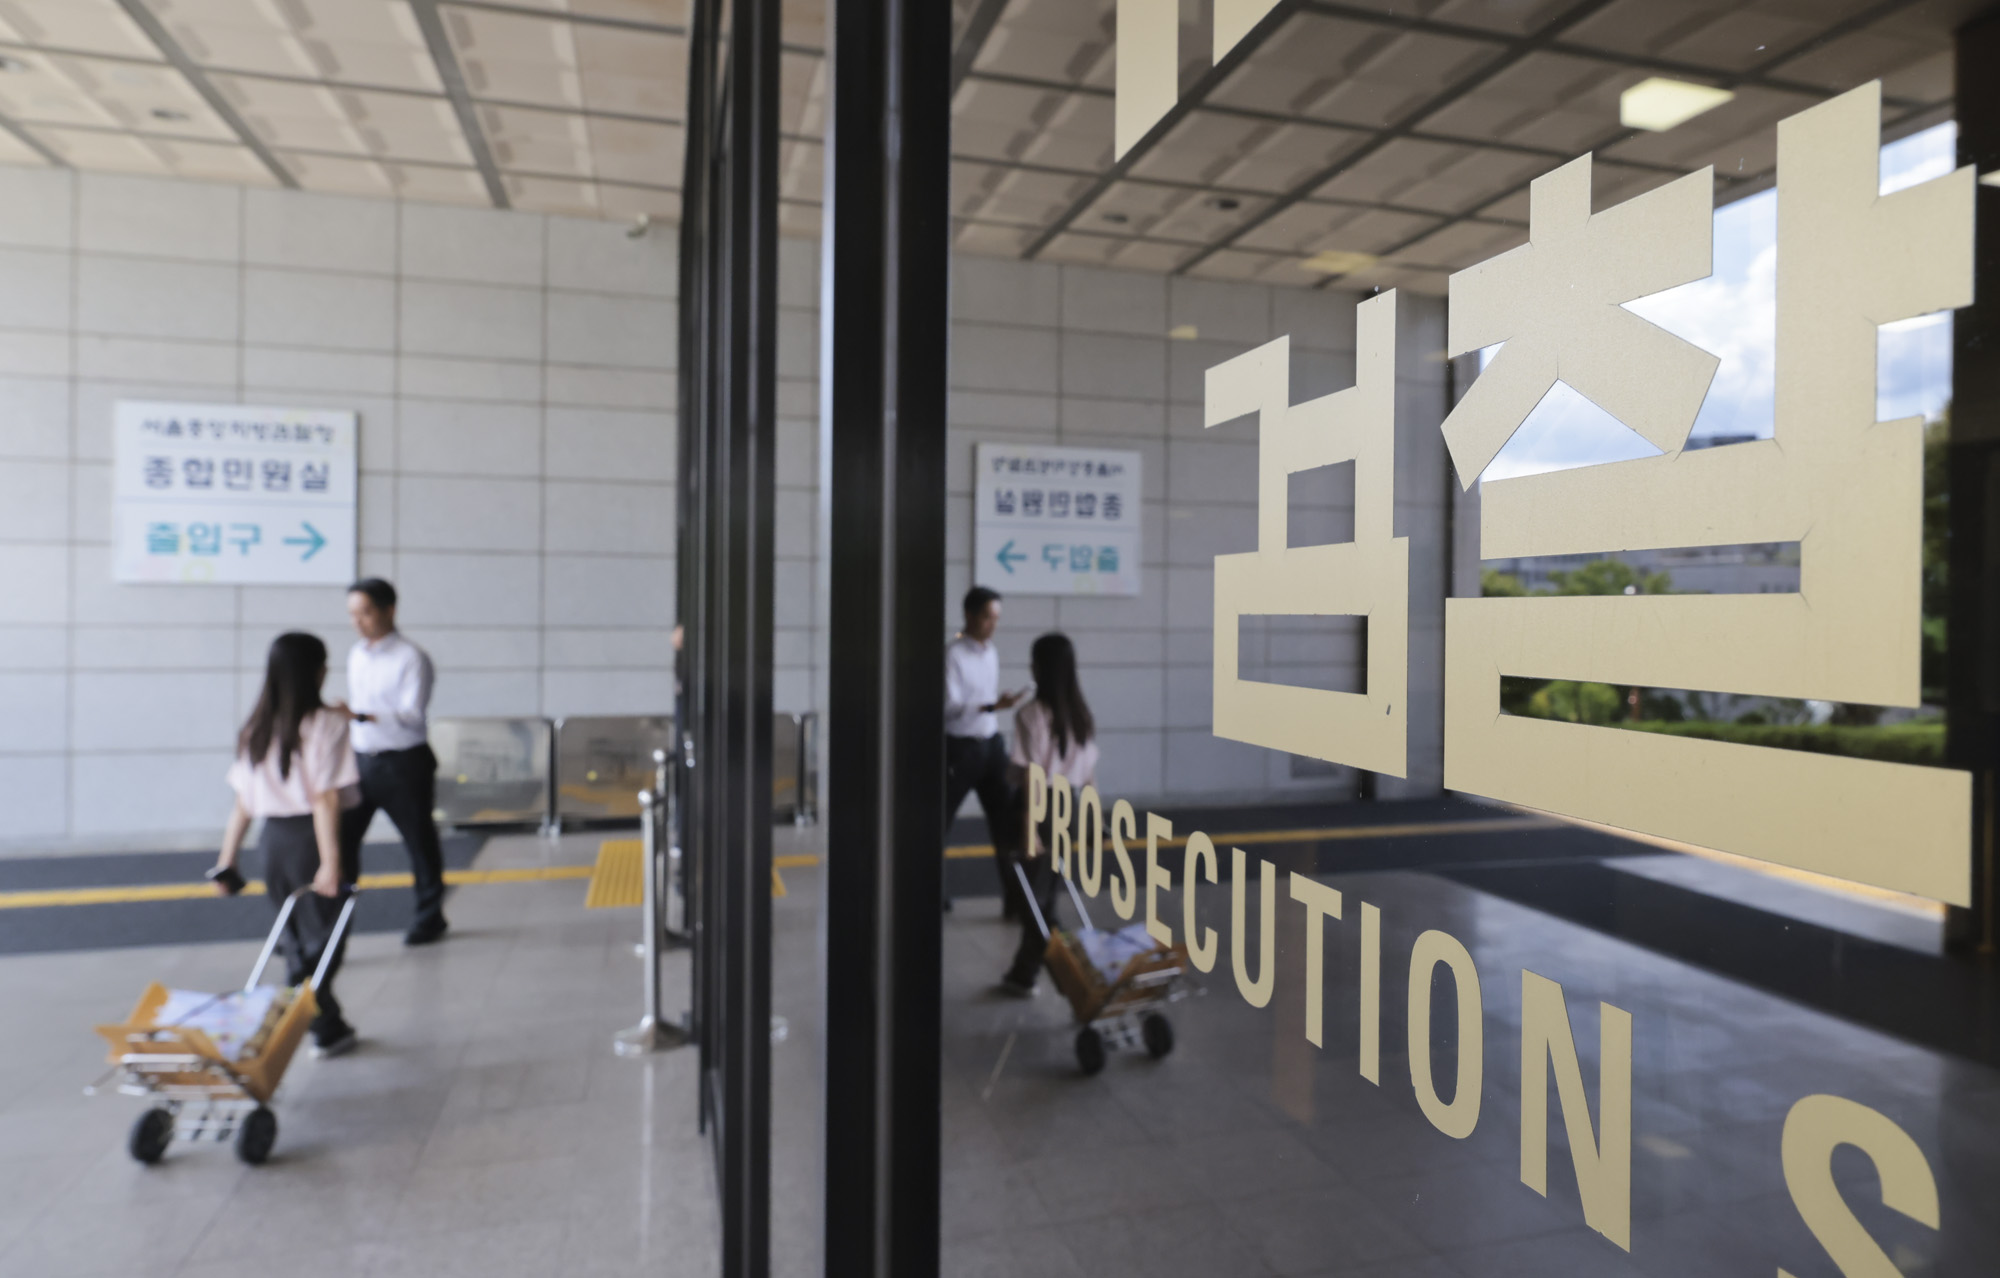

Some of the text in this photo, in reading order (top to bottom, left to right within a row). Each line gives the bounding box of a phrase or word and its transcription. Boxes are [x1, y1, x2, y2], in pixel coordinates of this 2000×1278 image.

[144, 455, 329, 493] 종합민원실
[147, 522, 262, 556] 출입구
[1205, 79, 1976, 908] 검찰
[1028, 761, 1632, 1253] PROSECUTION
